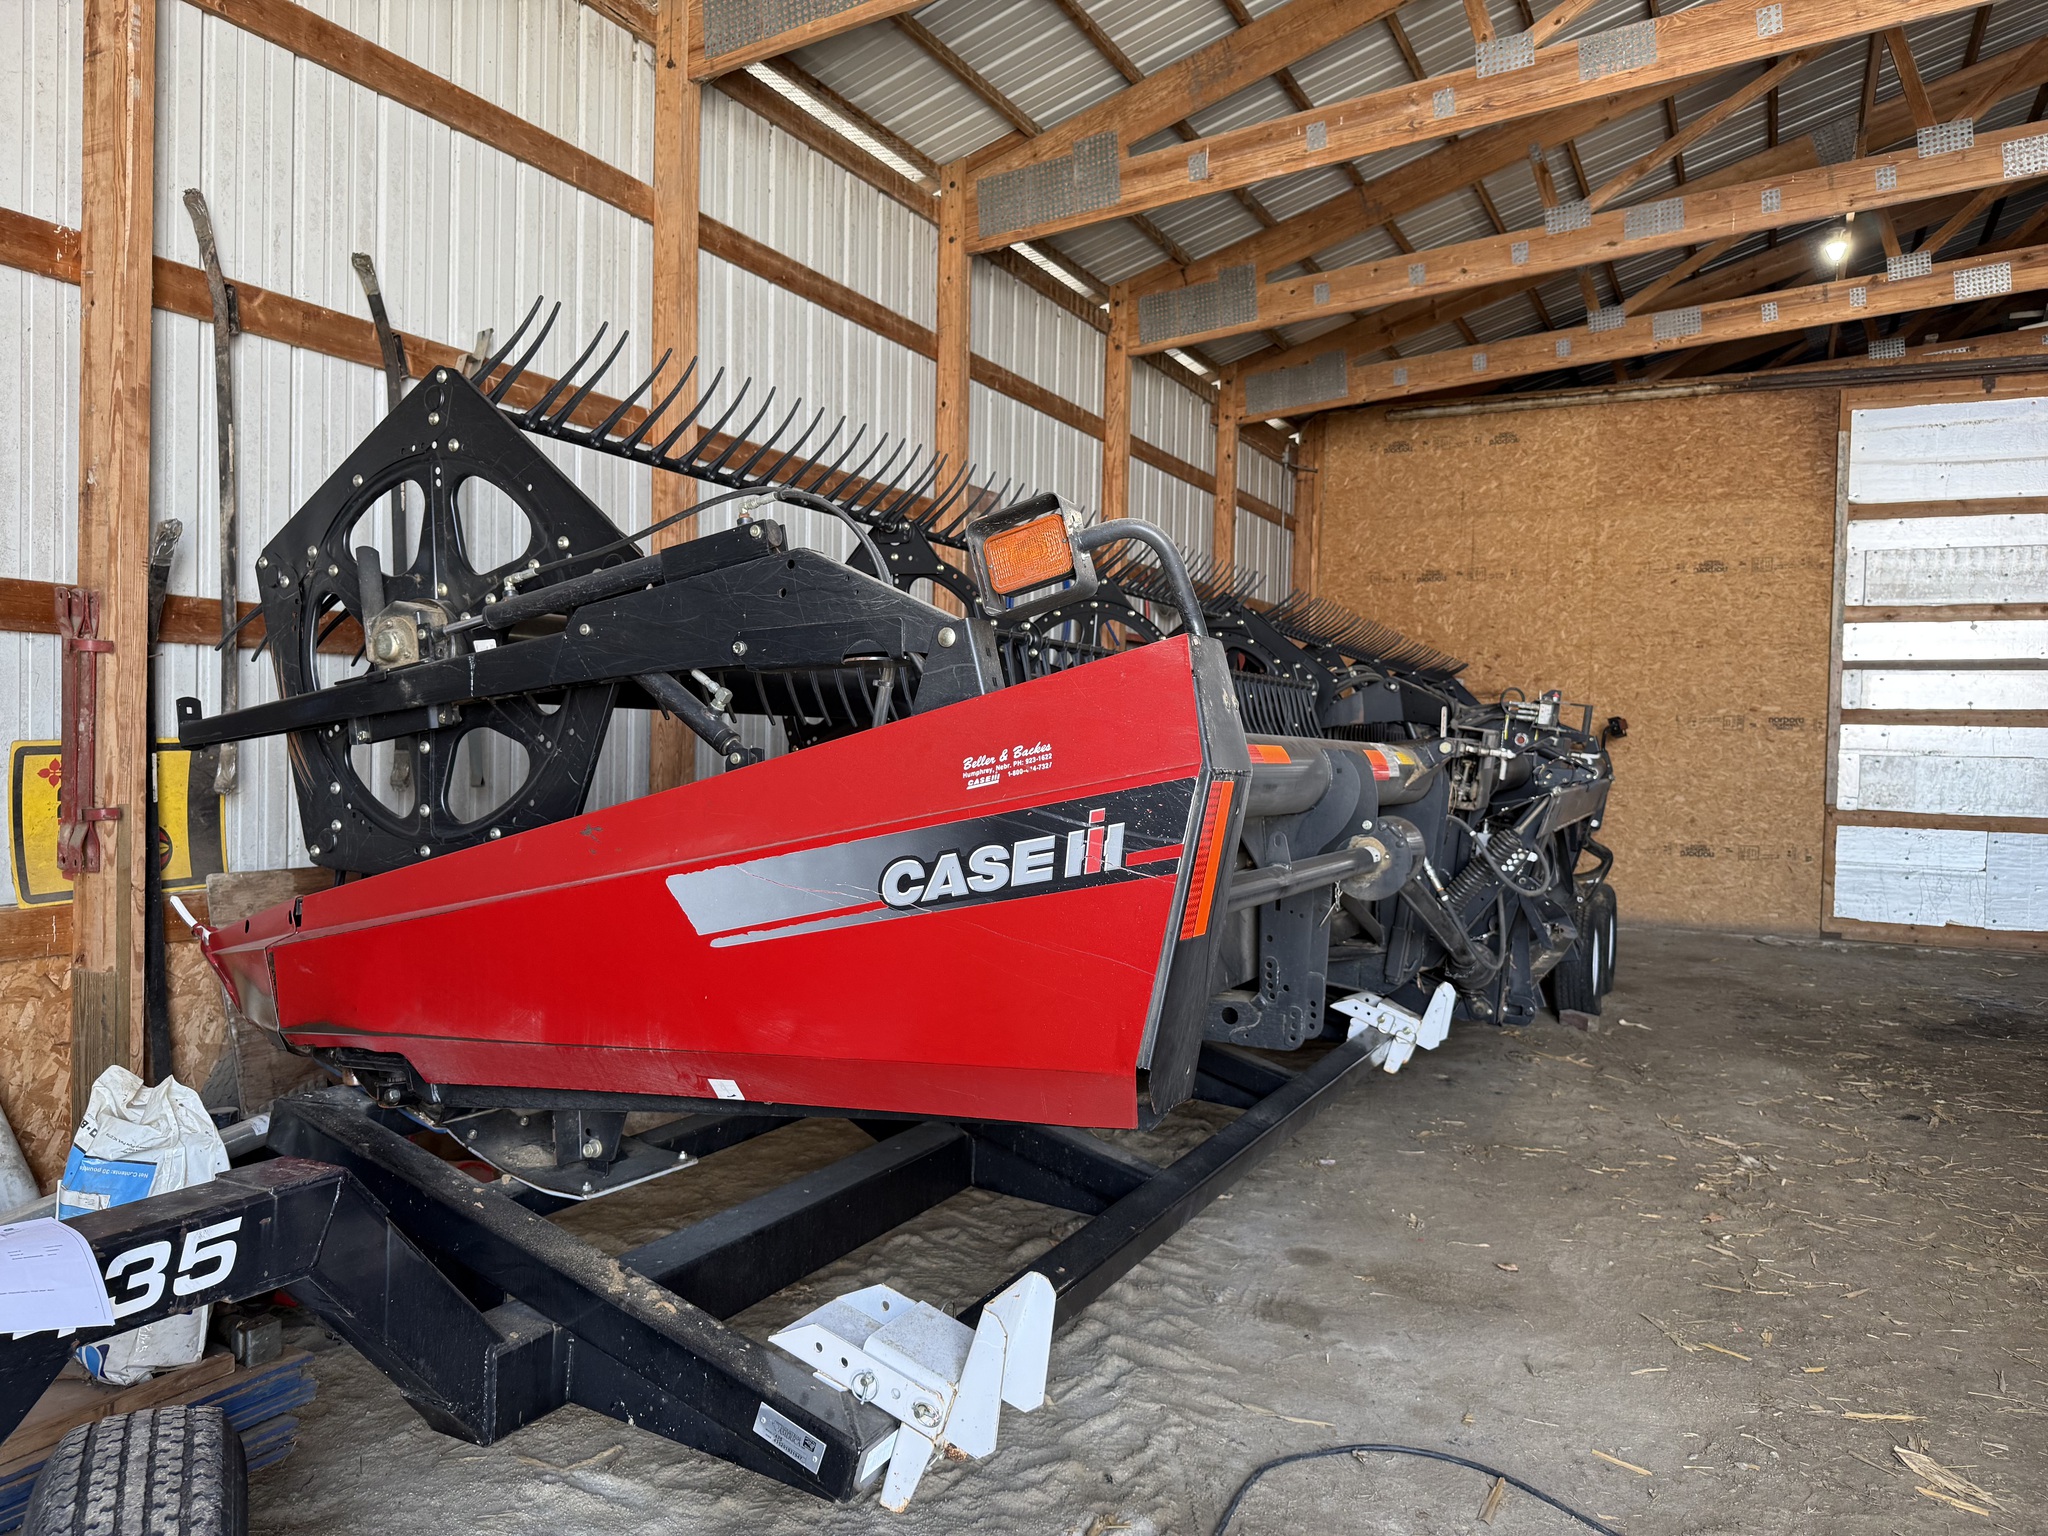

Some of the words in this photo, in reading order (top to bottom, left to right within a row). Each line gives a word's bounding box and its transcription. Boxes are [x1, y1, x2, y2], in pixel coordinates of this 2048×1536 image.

[1768, 716, 1805, 725] norbord
[962, 767, 995, 778] Humphrey,
[1013, 759, 1024, 767] PH:
[963, 754, 996, 770] Beller
[999, 748, 1008, 762] &
[1013, 741, 1052, 759] Backes
[881, 835, 1056, 907] CASE
[105, 1216, 243, 1320] 35
